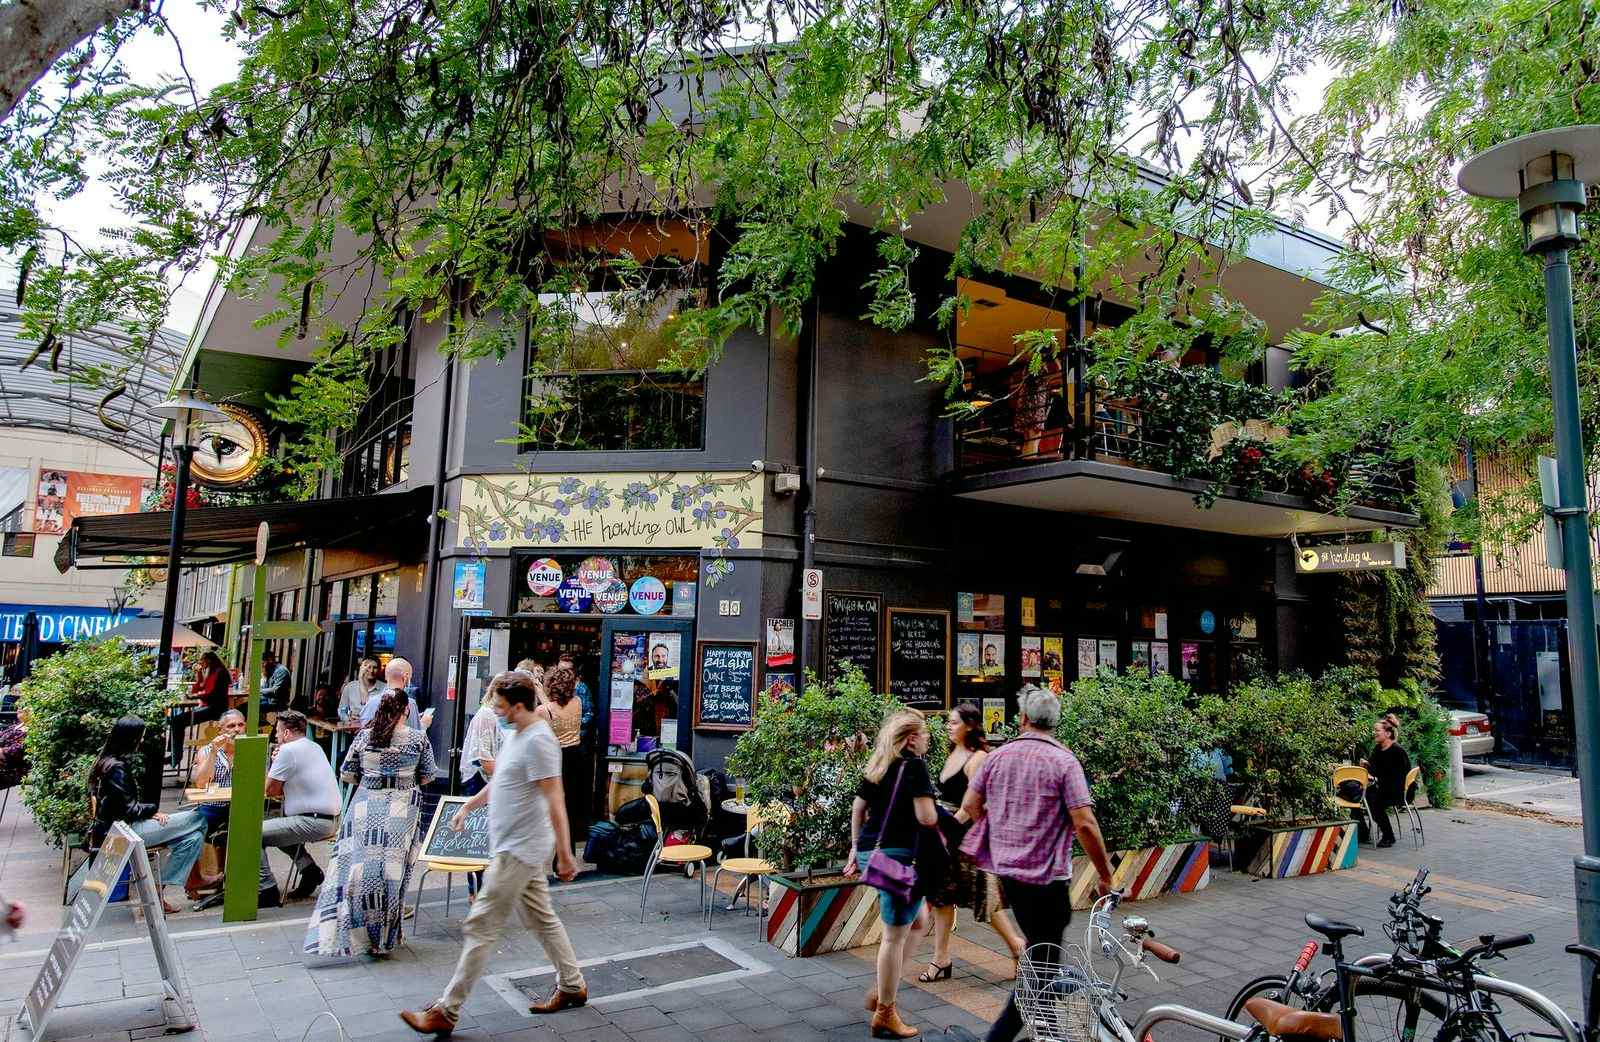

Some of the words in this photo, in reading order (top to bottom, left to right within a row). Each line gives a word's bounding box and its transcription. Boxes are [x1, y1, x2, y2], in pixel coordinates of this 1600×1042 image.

[571, 519, 592, 541] THE
[600, 511, 661, 544] howling
[665, 517, 692, 535] OWL
[529, 573, 561, 582] VENUE
[580, 570, 612, 579] VENUE
[559, 589, 592, 598] VENUE
[596, 592, 626, 601] VENUE
[632, 592, 664, 600] VENUE
[706, 650, 727, 658] HAPPY
[728, 658, 752, 670] GIN
